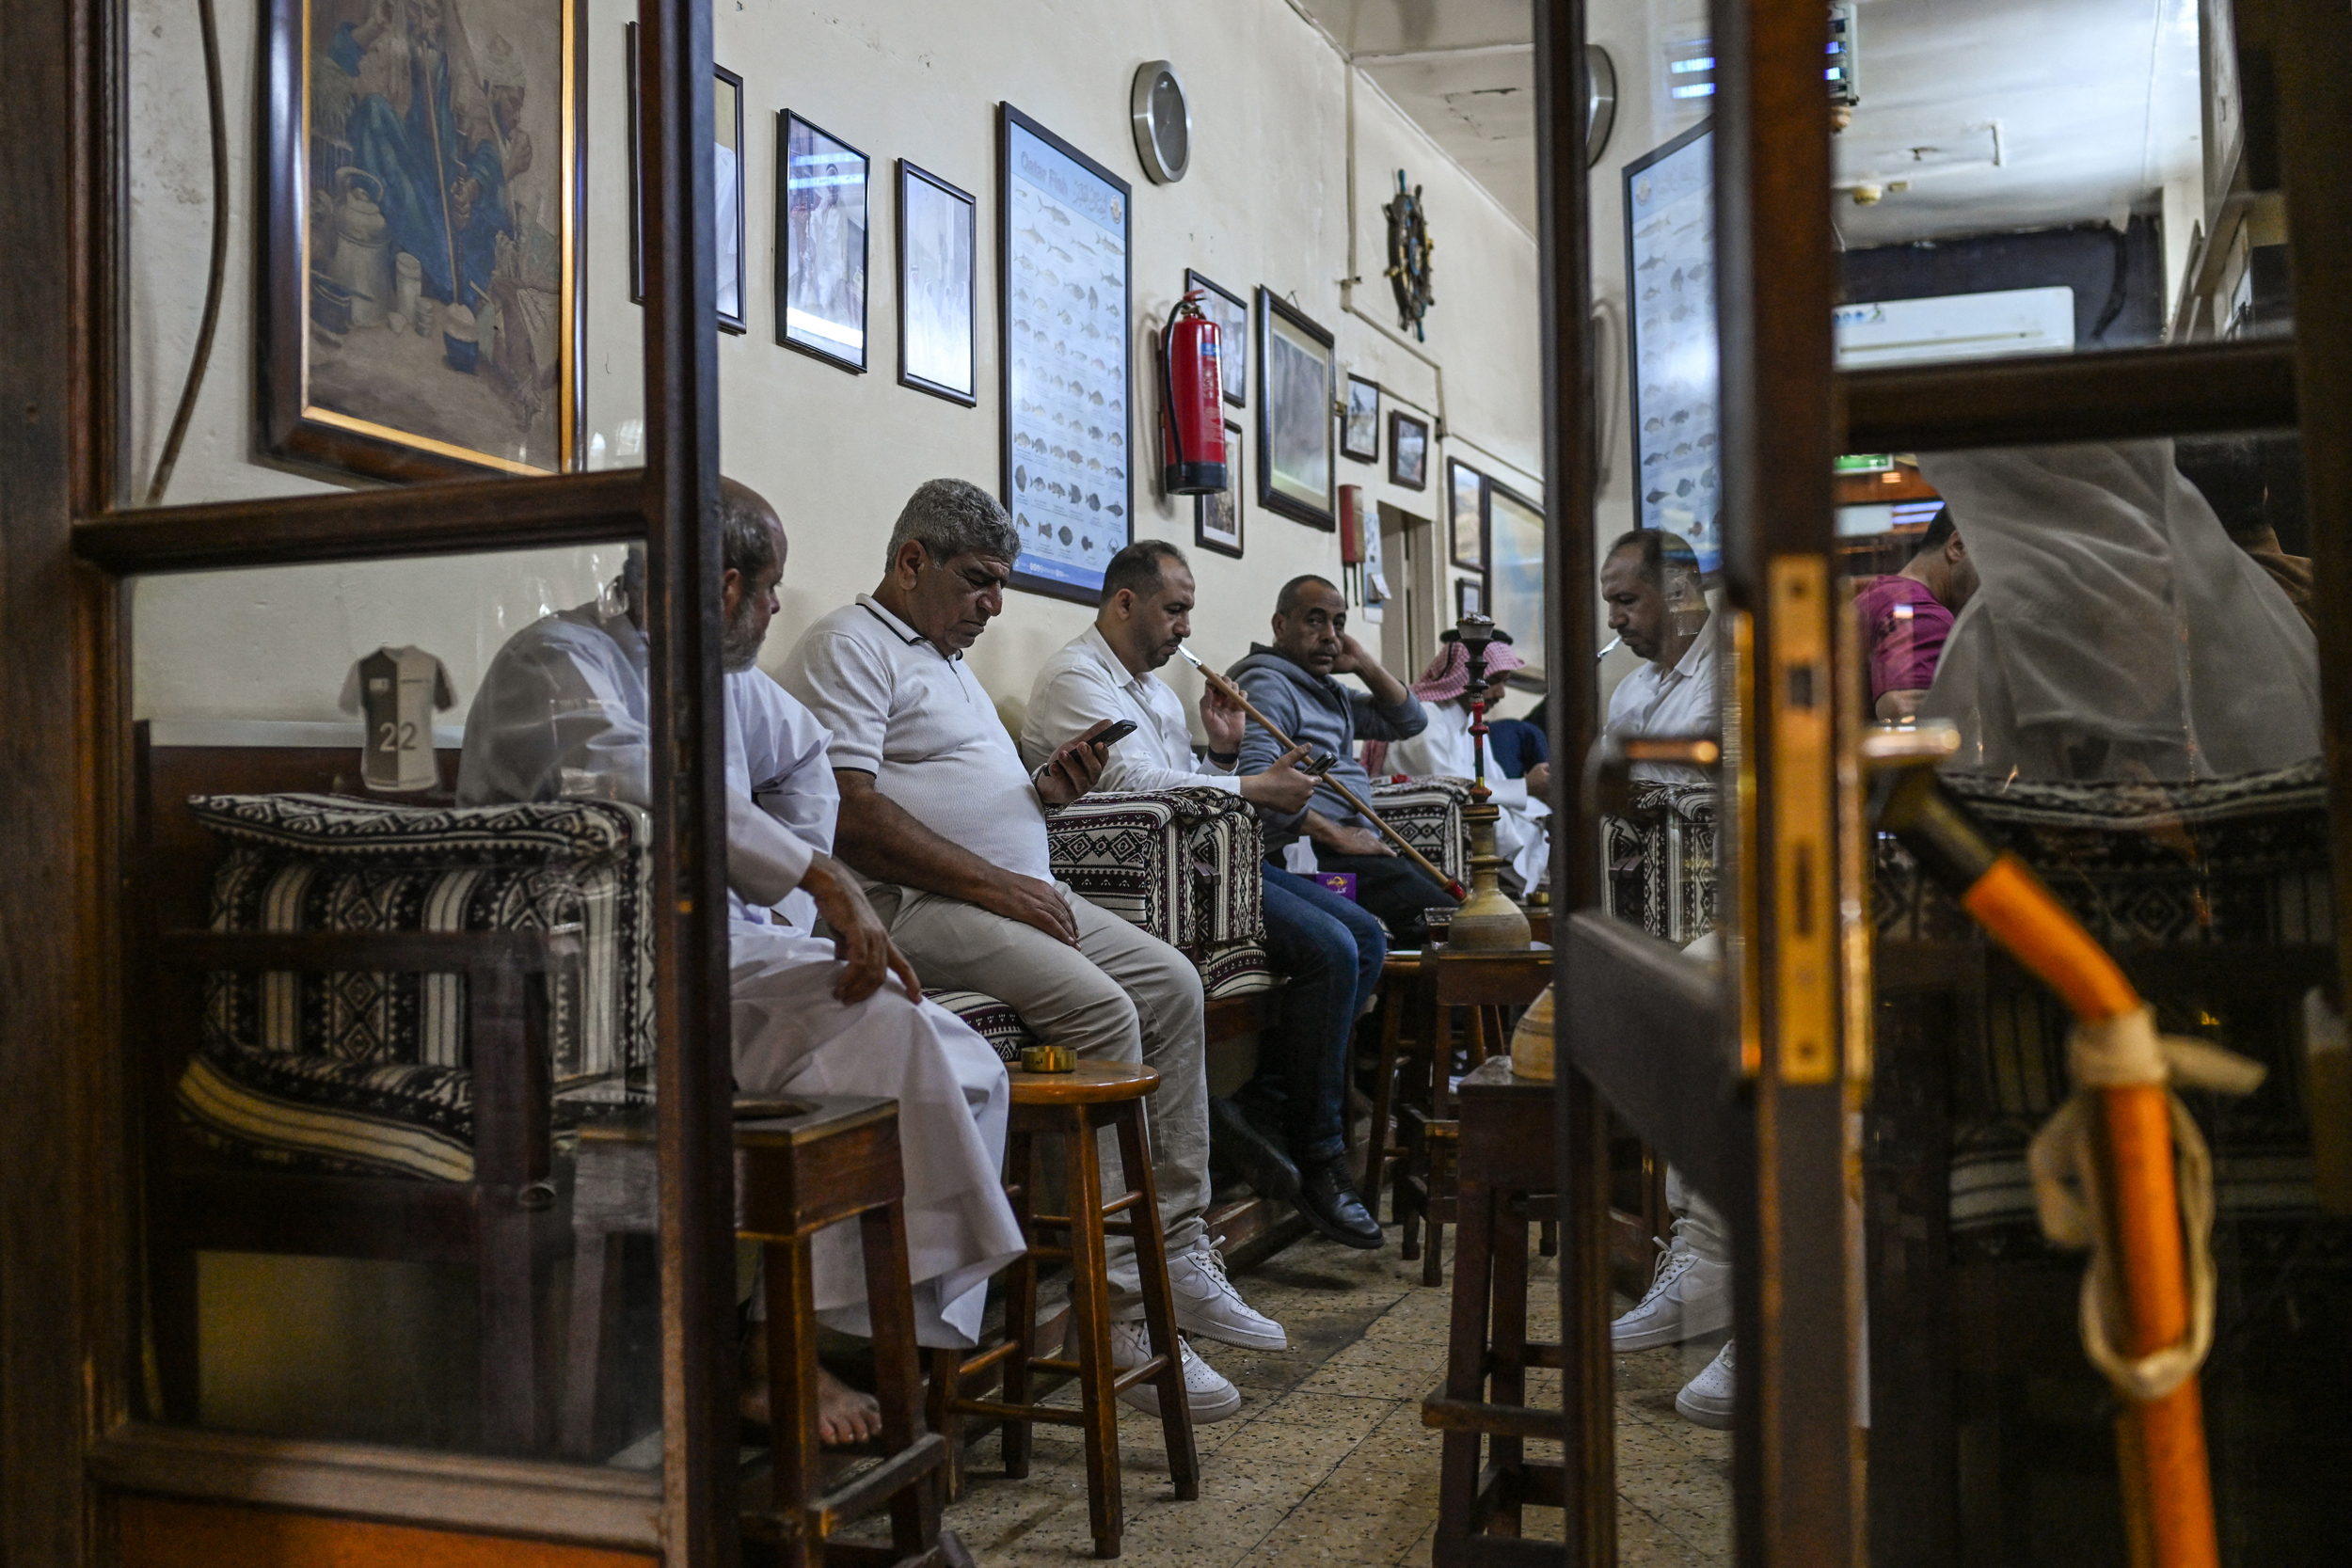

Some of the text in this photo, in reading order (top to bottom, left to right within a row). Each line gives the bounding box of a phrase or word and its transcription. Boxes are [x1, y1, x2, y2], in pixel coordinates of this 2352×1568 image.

[1021, 151, 1068, 196] Qatar Fish
[380, 722, 416, 752] 22
